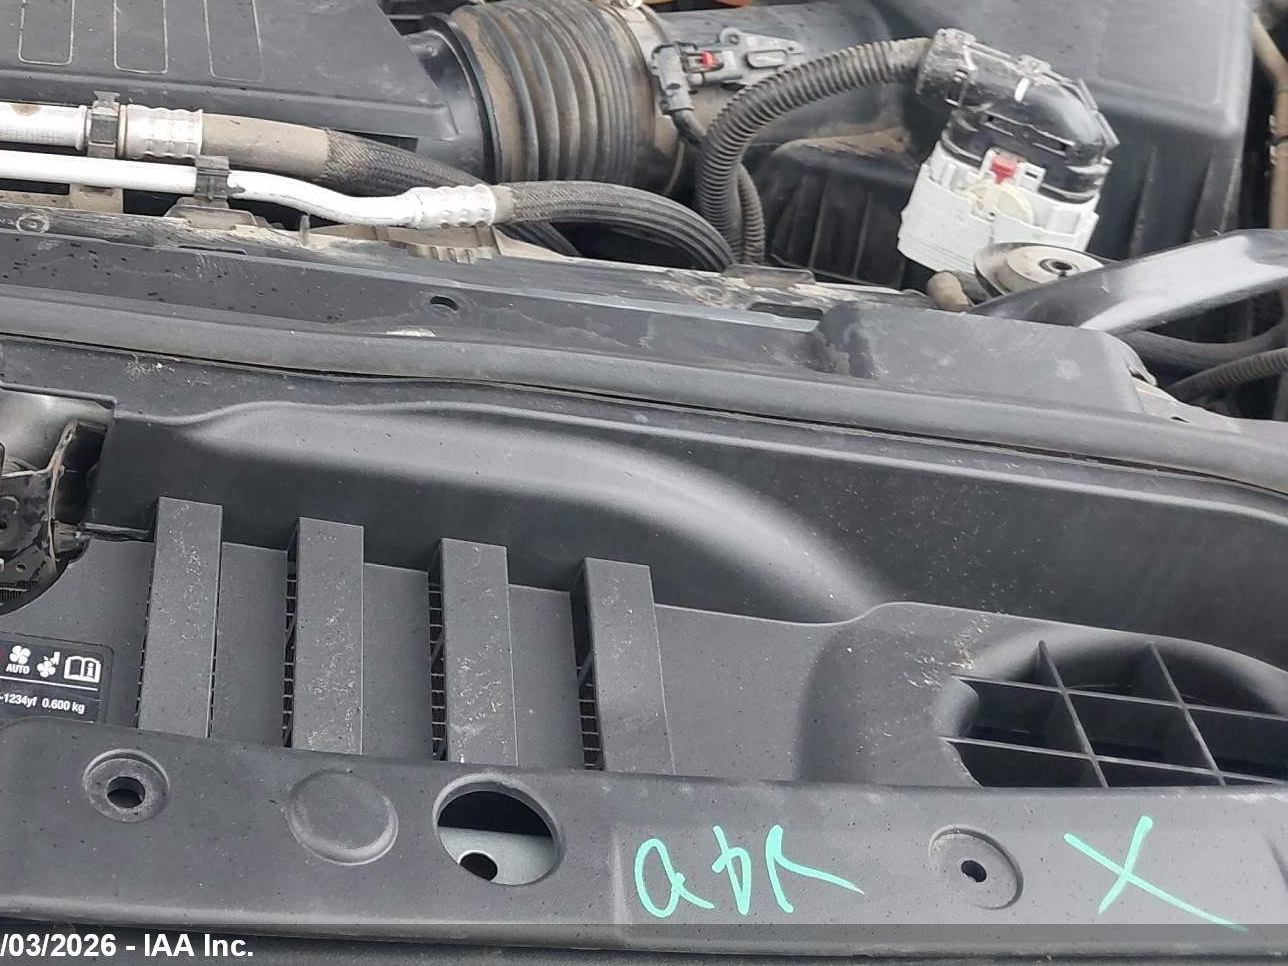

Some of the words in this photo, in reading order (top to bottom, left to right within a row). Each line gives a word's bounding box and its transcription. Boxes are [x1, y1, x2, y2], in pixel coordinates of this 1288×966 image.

[5, 663, 31, 674] AUTO
[41, 697, 71, 711] 0.600
[72, 701, 86, 715] kg
